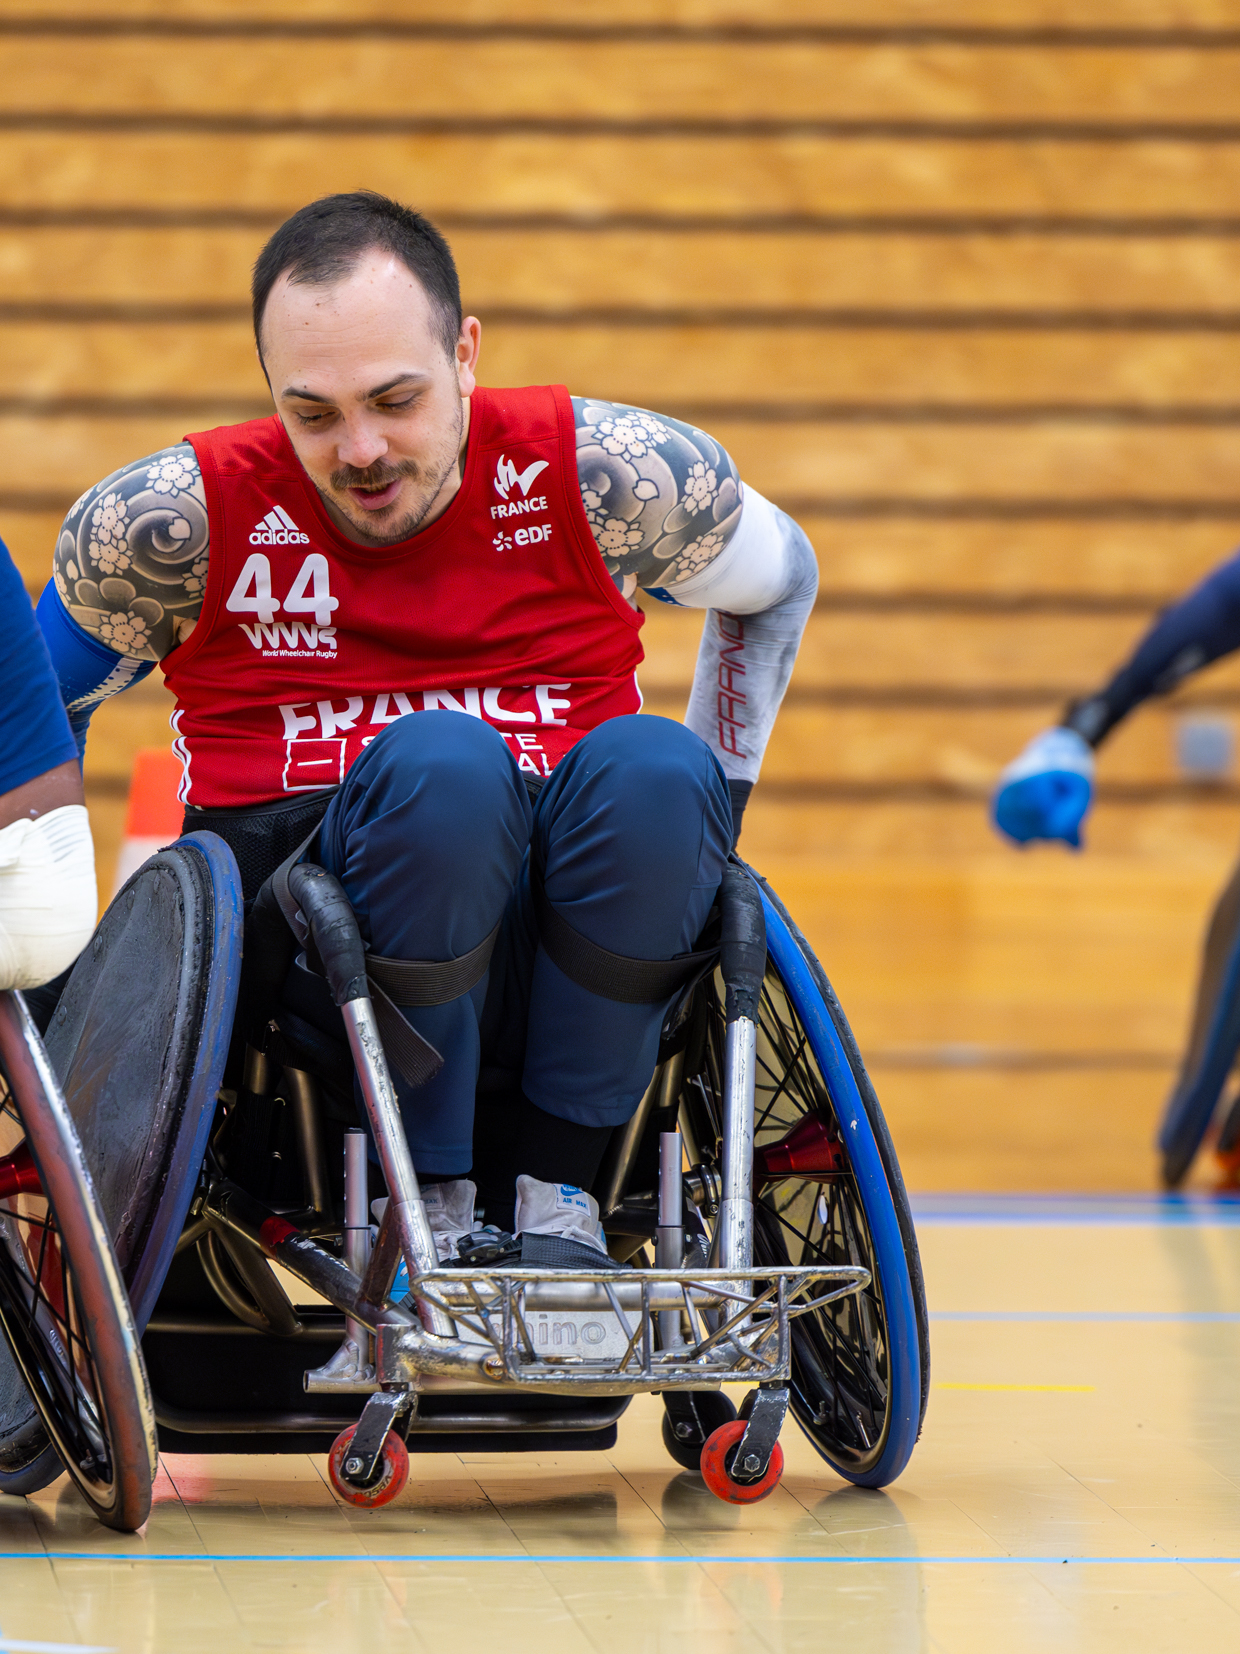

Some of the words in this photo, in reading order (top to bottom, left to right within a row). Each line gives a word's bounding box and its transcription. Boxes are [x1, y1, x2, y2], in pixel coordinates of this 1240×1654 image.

[490, 496, 549, 520] FRANCE
[248, 528, 310, 545] adidas
[225, 553, 340, 627] 44
[262, 649, 278, 657] World
[279, 649, 315, 657] Wheelchair
[316, 650, 338, 659] Rugby
[717, 611, 748, 760] FRANC
[278, 682, 572, 740] FRANCE
